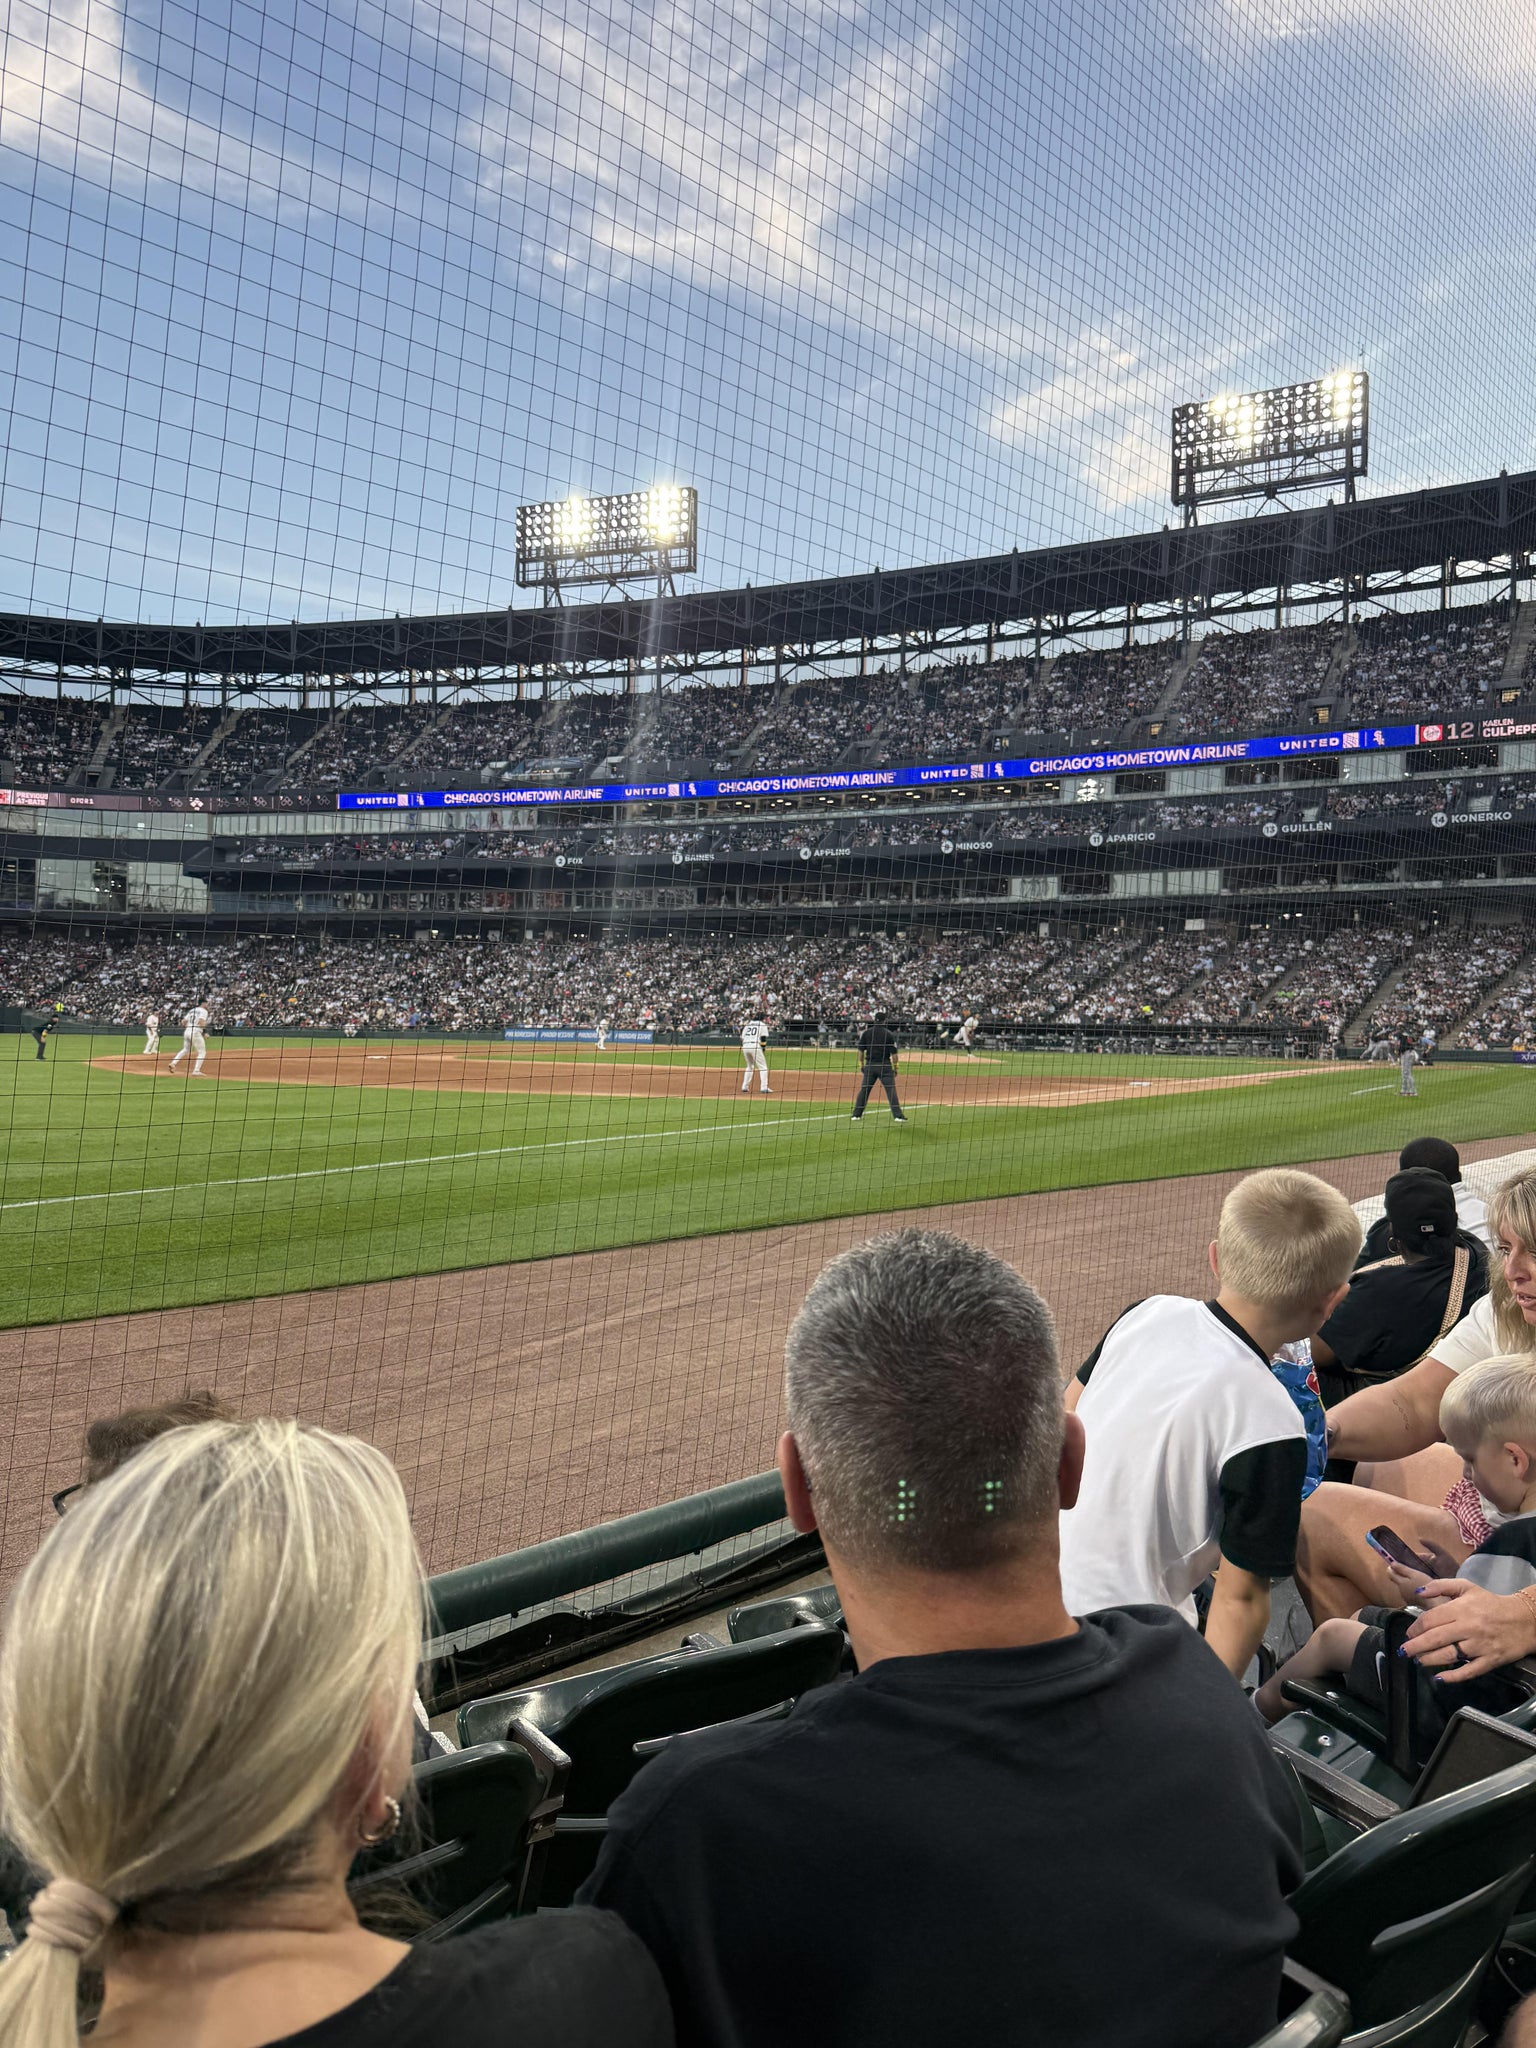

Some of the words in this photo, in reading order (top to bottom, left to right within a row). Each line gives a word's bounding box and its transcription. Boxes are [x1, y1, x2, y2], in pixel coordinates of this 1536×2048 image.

[1482, 718, 1514, 727] KAELEN
[1447, 721, 1475, 740] 12
[1279, 737, 1340, 751] UNITED
[1029, 755, 1104, 773] CHICAGO'S
[1106, 749, 1190, 767] HOMETOWN
[1191, 744, 1247, 760] AIRLINE
[920, 768, 969, 779] UNITED
[718, 779, 781, 793] CHICAGO'S
[782, 775, 849, 790] HOMETOWN
[850, 772, 894, 786] AIRLINE
[443, 792, 501, 804] CHICAGO'S
[502, 790, 562, 802] HOMETOWN
[624, 787, 667, 796] UNITED
[356, 797, 396, 805] UNITED
[1451, 812, 1512, 824] KONERKO
[1106, 832, 1155, 843] APARICIO
[684, 854, 715, 862] BAINES
[814, 848, 851, 857] APPLING
[567, 857, 583, 865] FOX
[745, 1027, 757, 1036] 20
